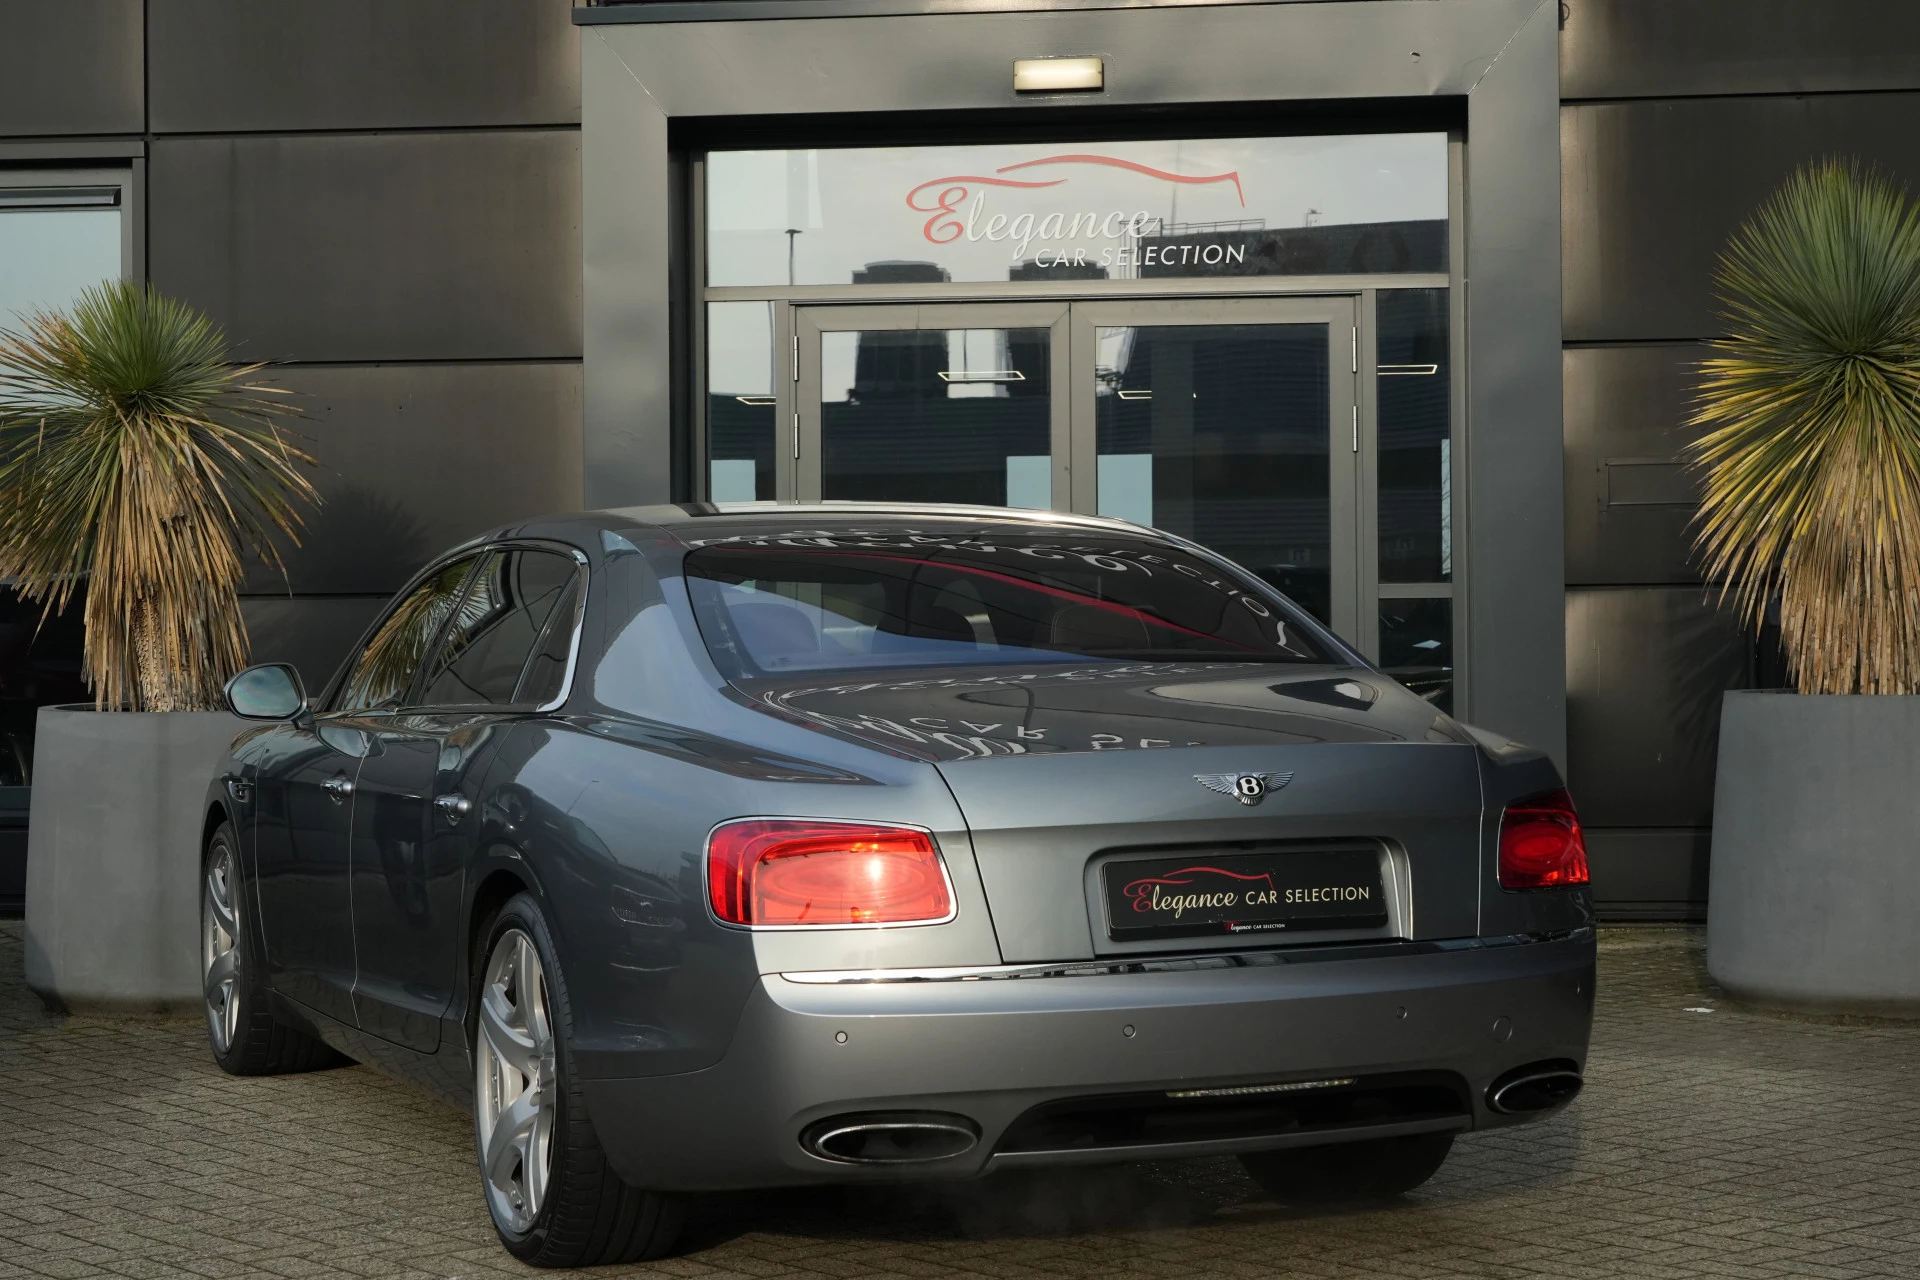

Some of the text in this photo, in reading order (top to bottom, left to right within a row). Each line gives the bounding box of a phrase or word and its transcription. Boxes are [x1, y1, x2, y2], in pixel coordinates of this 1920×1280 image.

[906, 175, 1161, 261] Elegance
[1035, 243, 1246, 269] CAR SELECTION
[1239, 775, 1260, 796] B
[1123, 878, 1370, 919] Elegance CAR SELECTION
